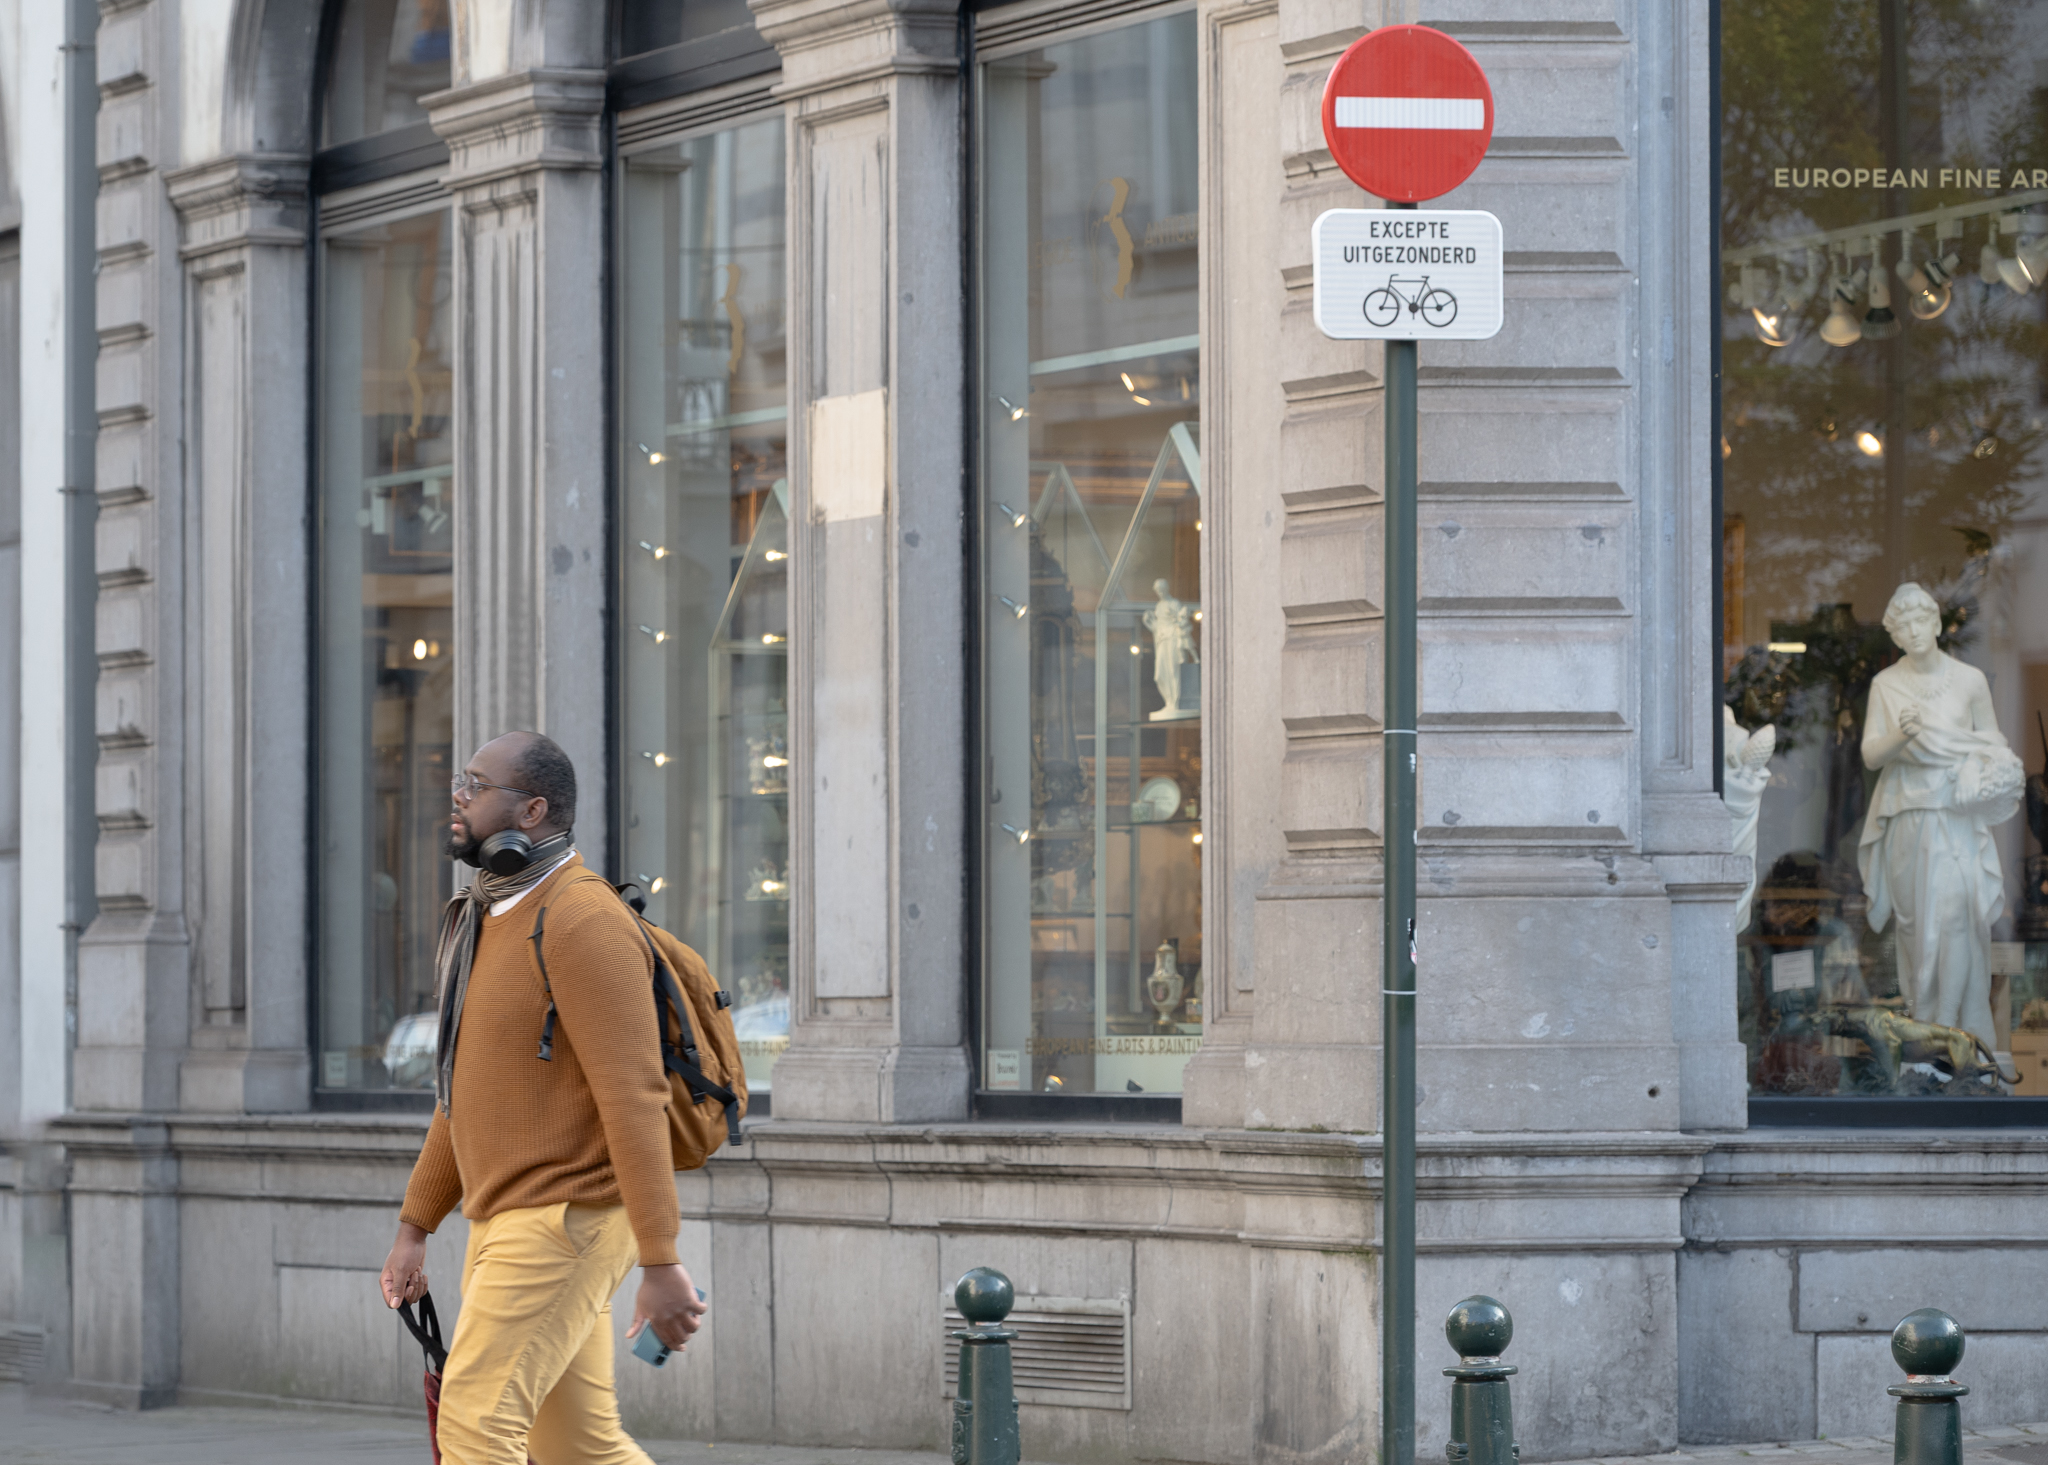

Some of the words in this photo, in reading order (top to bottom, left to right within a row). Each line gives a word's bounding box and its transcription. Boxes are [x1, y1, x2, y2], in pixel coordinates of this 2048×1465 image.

[1774, 168, 1929, 188] EUROPEAN
[1939, 168, 2001, 188] FINE
[2010, 168, 2048, 188] AR
[1143, 212, 1198, 247] ANTIQU
[1370, 221, 1449, 239] EXCEPTE
[1343, 246, 1476, 264] UITGEZONDERD
[1115, 1037, 1145, 1055] ARTS
[1148, 1037, 1155, 1055] &
